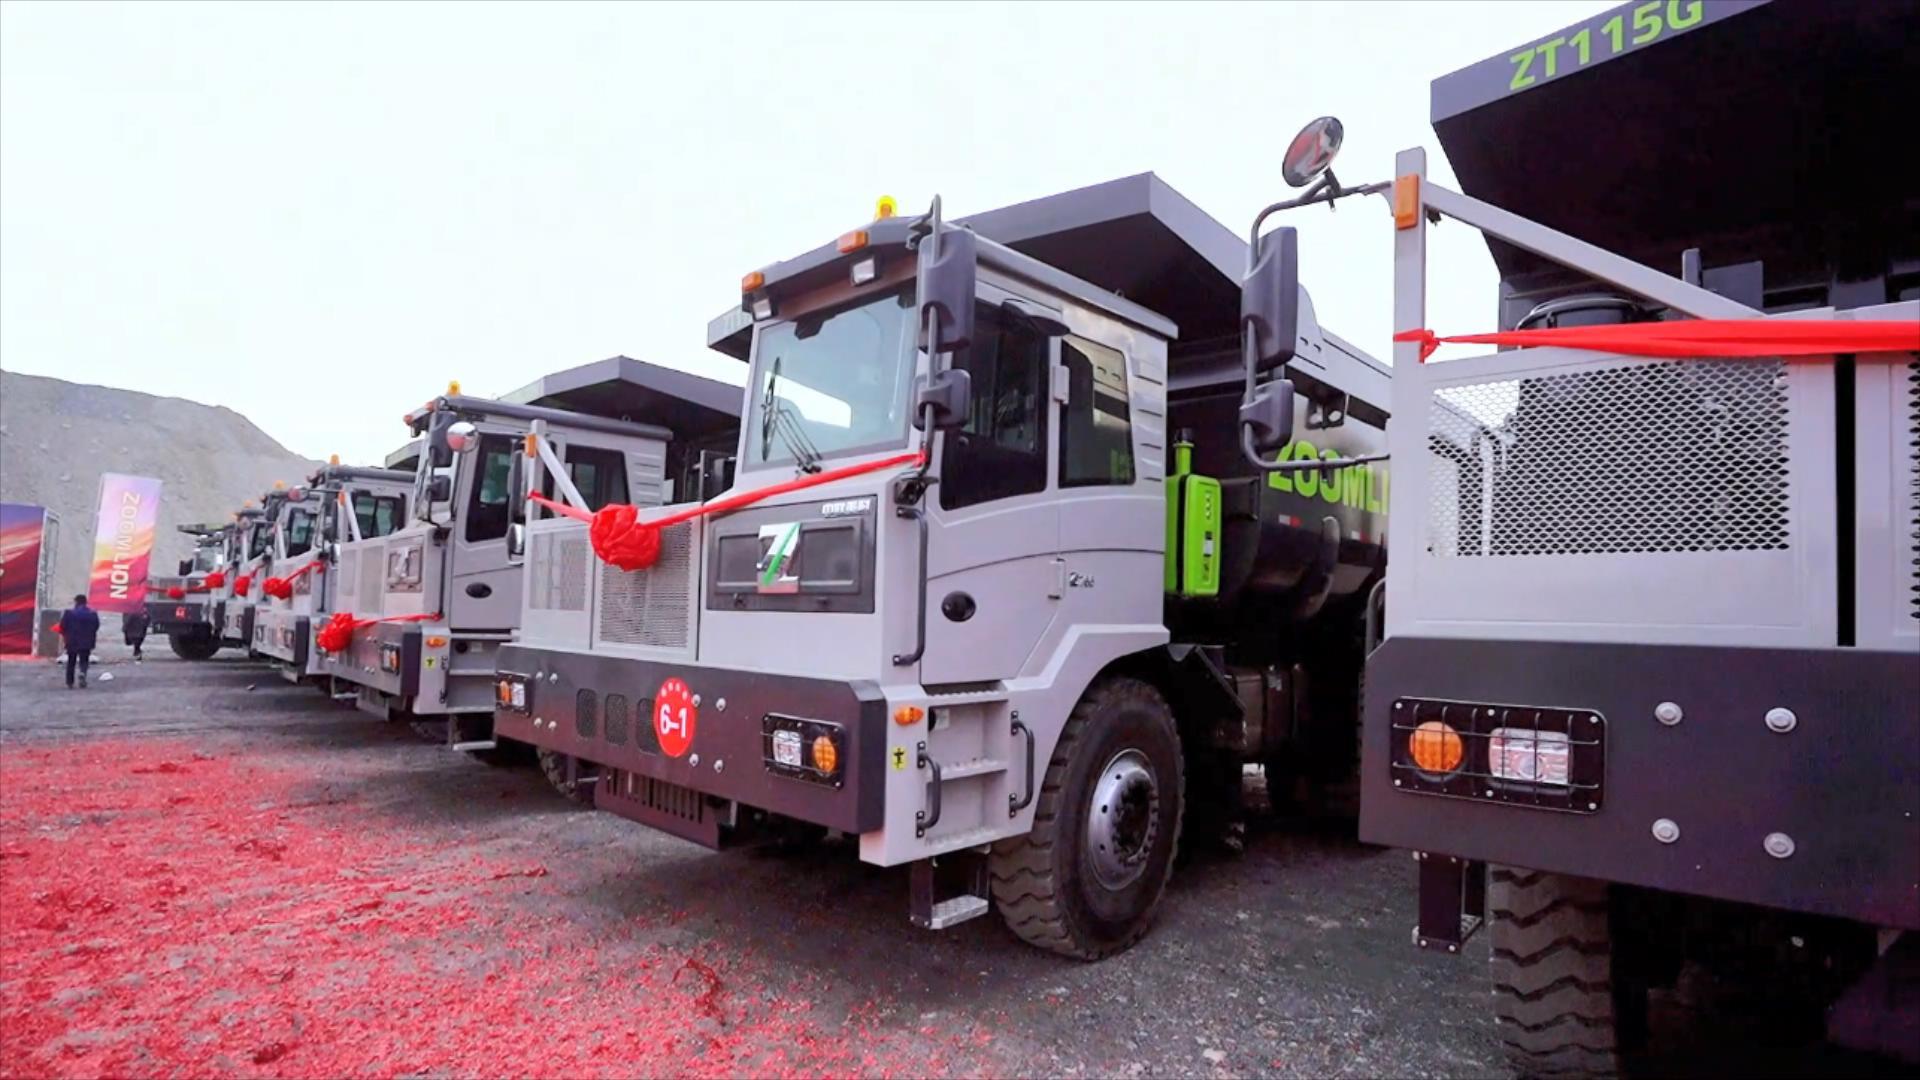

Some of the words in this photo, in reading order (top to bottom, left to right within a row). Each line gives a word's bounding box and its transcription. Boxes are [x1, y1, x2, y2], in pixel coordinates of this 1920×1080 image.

[1510, 0, 1703, 91] ZT115G
[110, 491, 140, 599] ZOOMLION
[660, 703, 688, 739] 6-1
